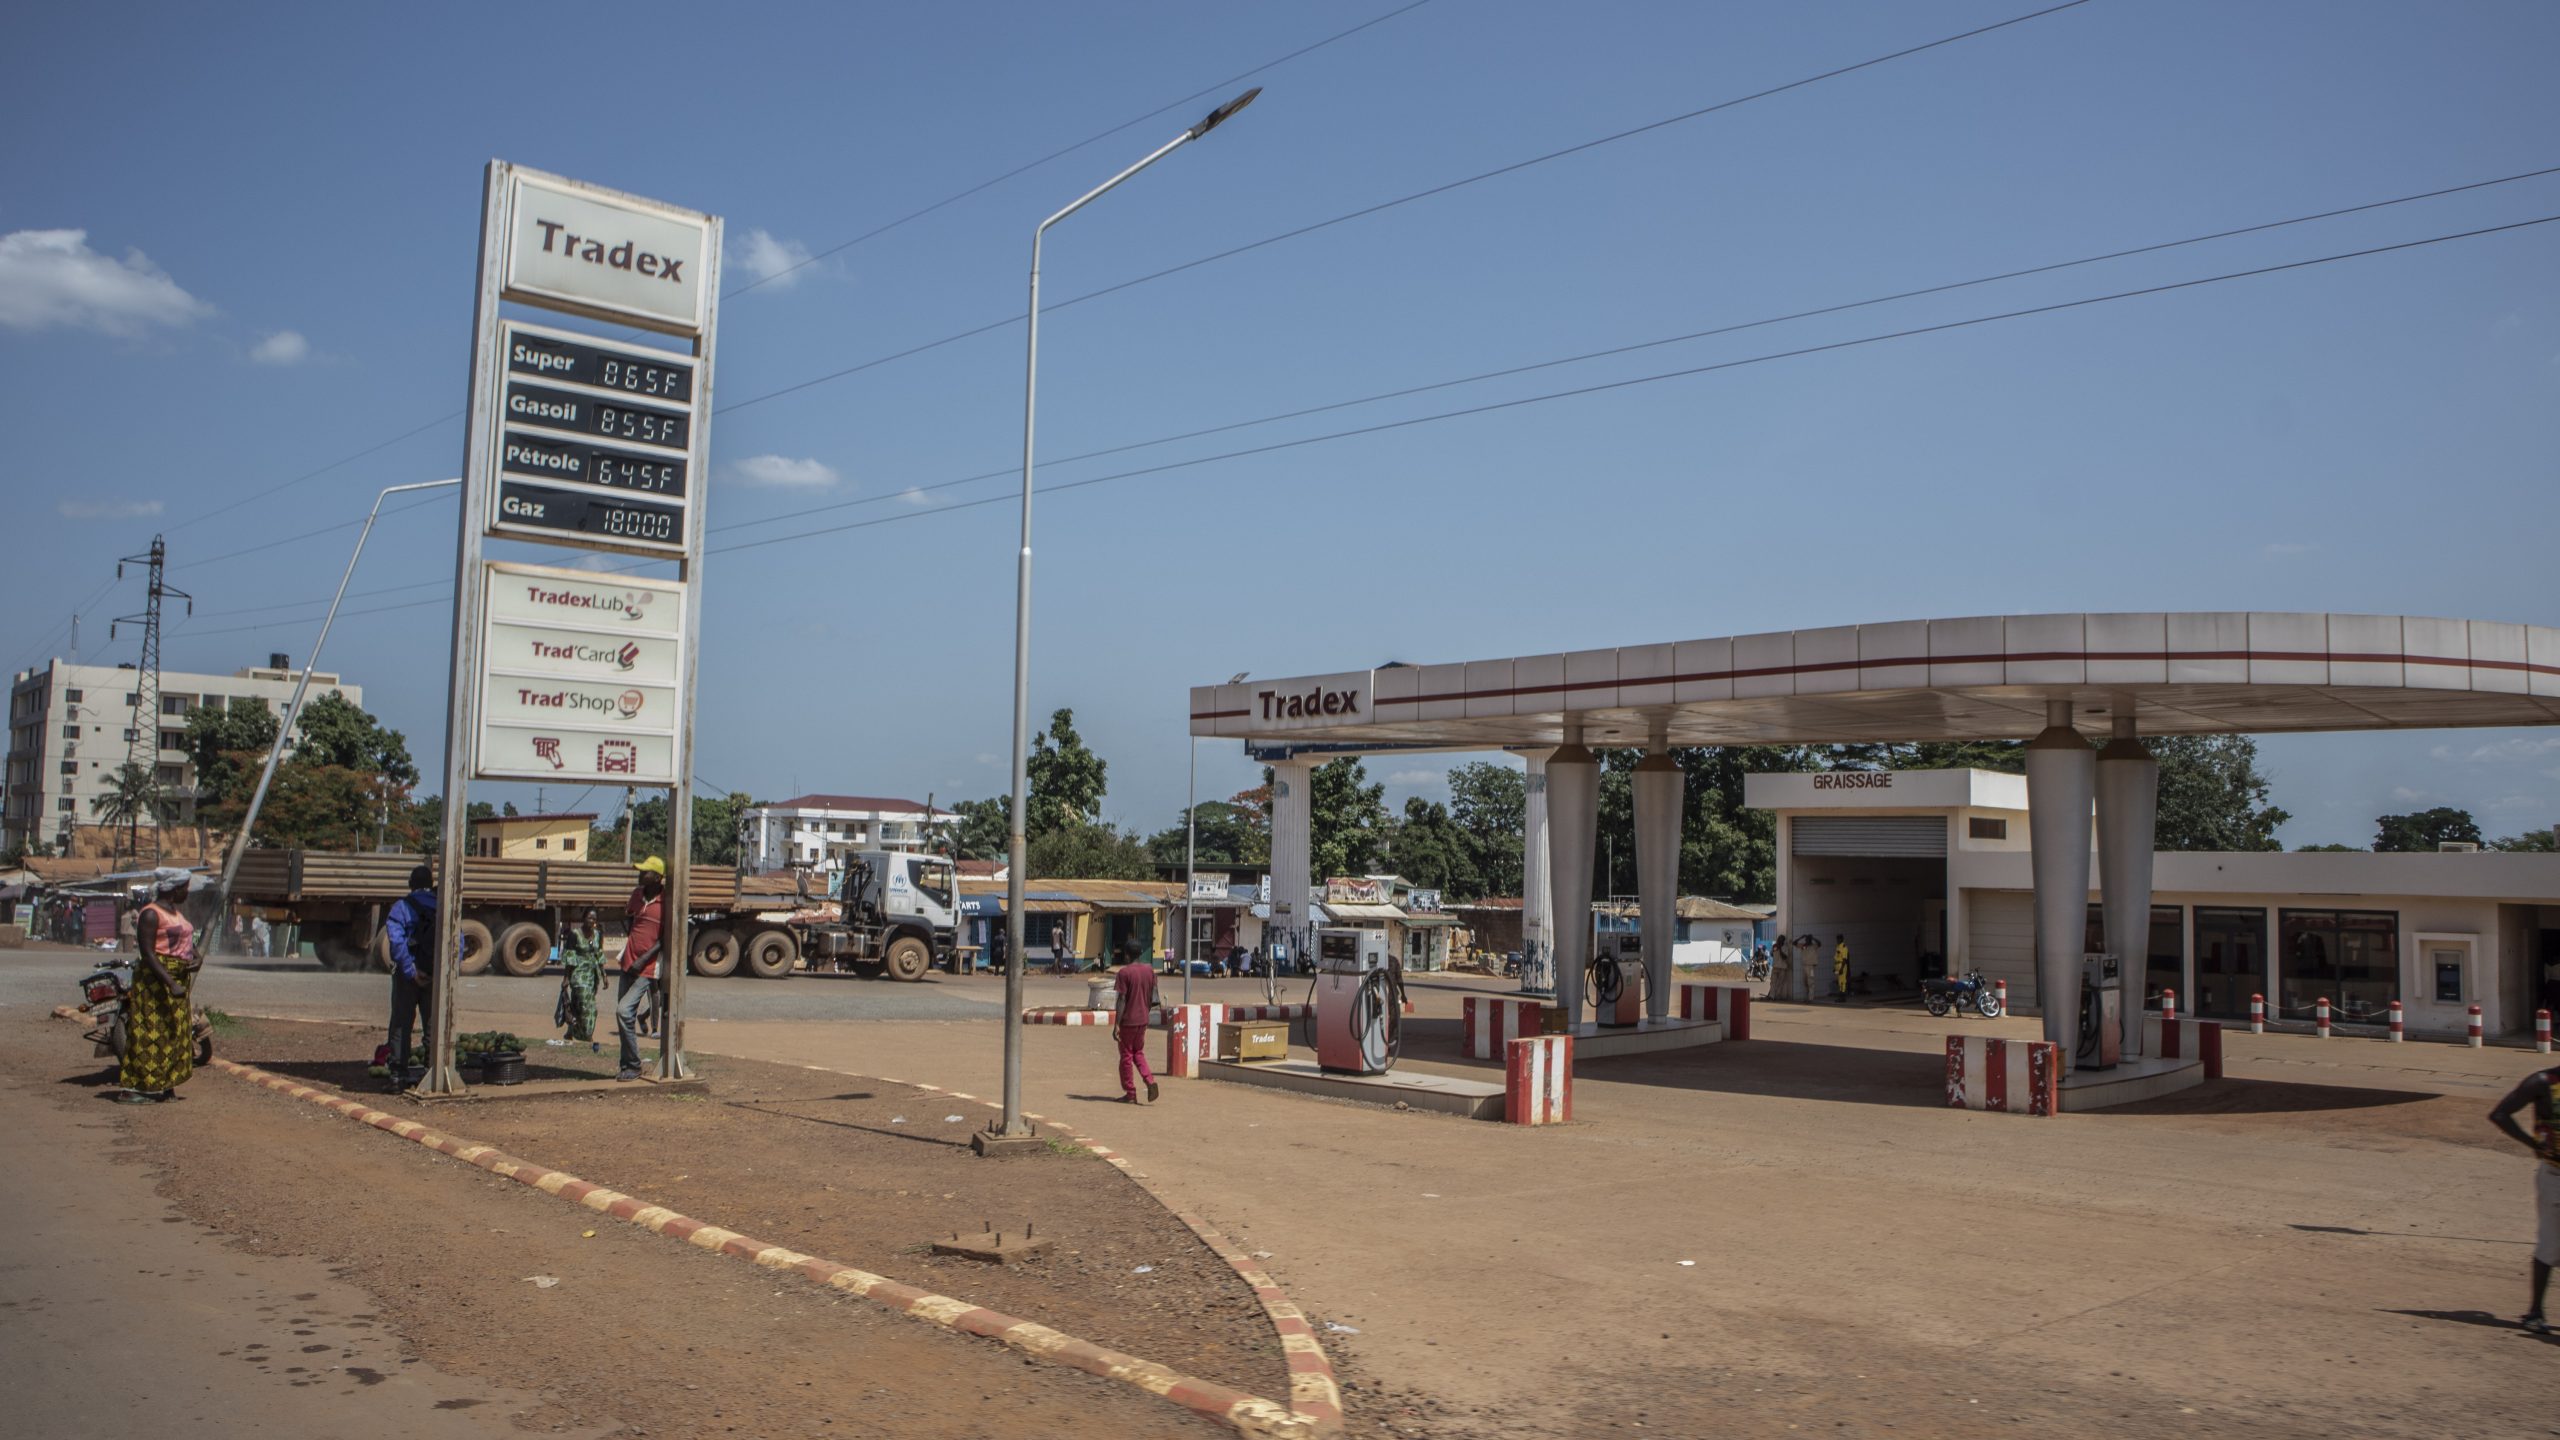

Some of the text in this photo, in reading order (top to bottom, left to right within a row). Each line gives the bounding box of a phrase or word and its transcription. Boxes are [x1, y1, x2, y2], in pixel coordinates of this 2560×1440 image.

[536, 218, 684, 284] Tradex
[513, 344, 575, 371] Super
[510, 394, 675, 441] Gasoil 855F
[506, 444, 673, 490] Pétrole 645F
[502, 496, 671, 539] Gaz 18000
[1258, 686, 1359, 719] Tradex
[1813, 772, 1892, 790] GRAISSAGE
